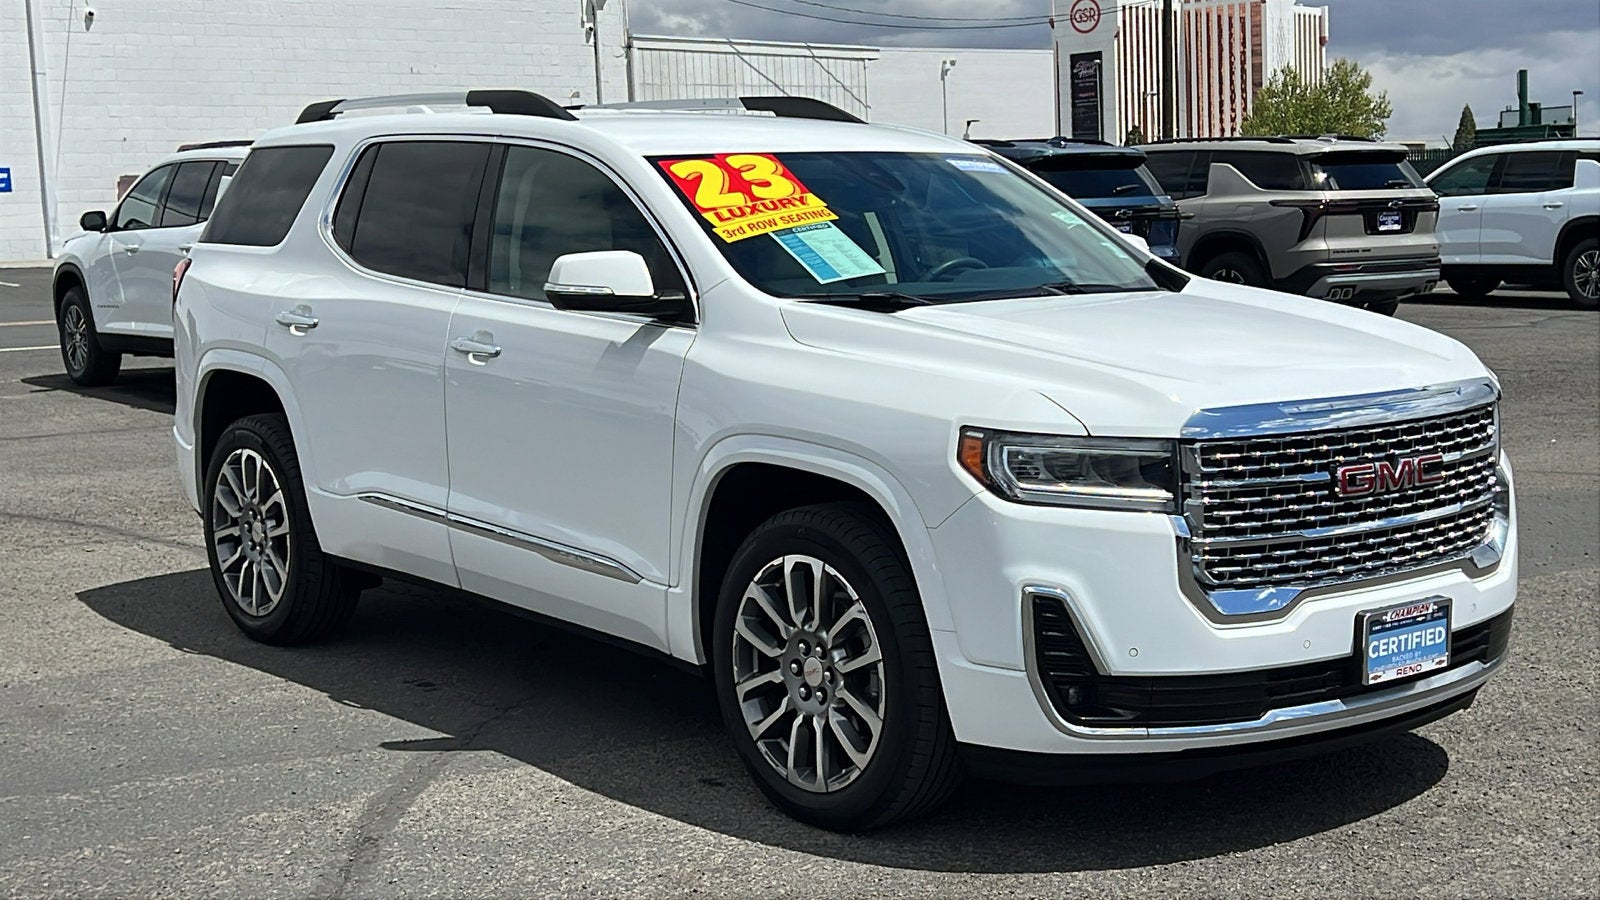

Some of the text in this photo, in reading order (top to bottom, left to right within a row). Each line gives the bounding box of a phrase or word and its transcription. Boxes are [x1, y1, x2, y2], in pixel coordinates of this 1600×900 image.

[1073, 7, 1096, 24] GSR
[669, 154, 800, 209] 23
[713, 196, 809, 223] LUXURY
[722, 209, 832, 239] 3rd ROW SEATING
[1338, 455, 1444, 496] GMC
[1390, 603, 1431, 620] CHAMPION
[1368, 626, 1446, 659] CERTIFIED
[1396, 664, 1422, 675] RENO
